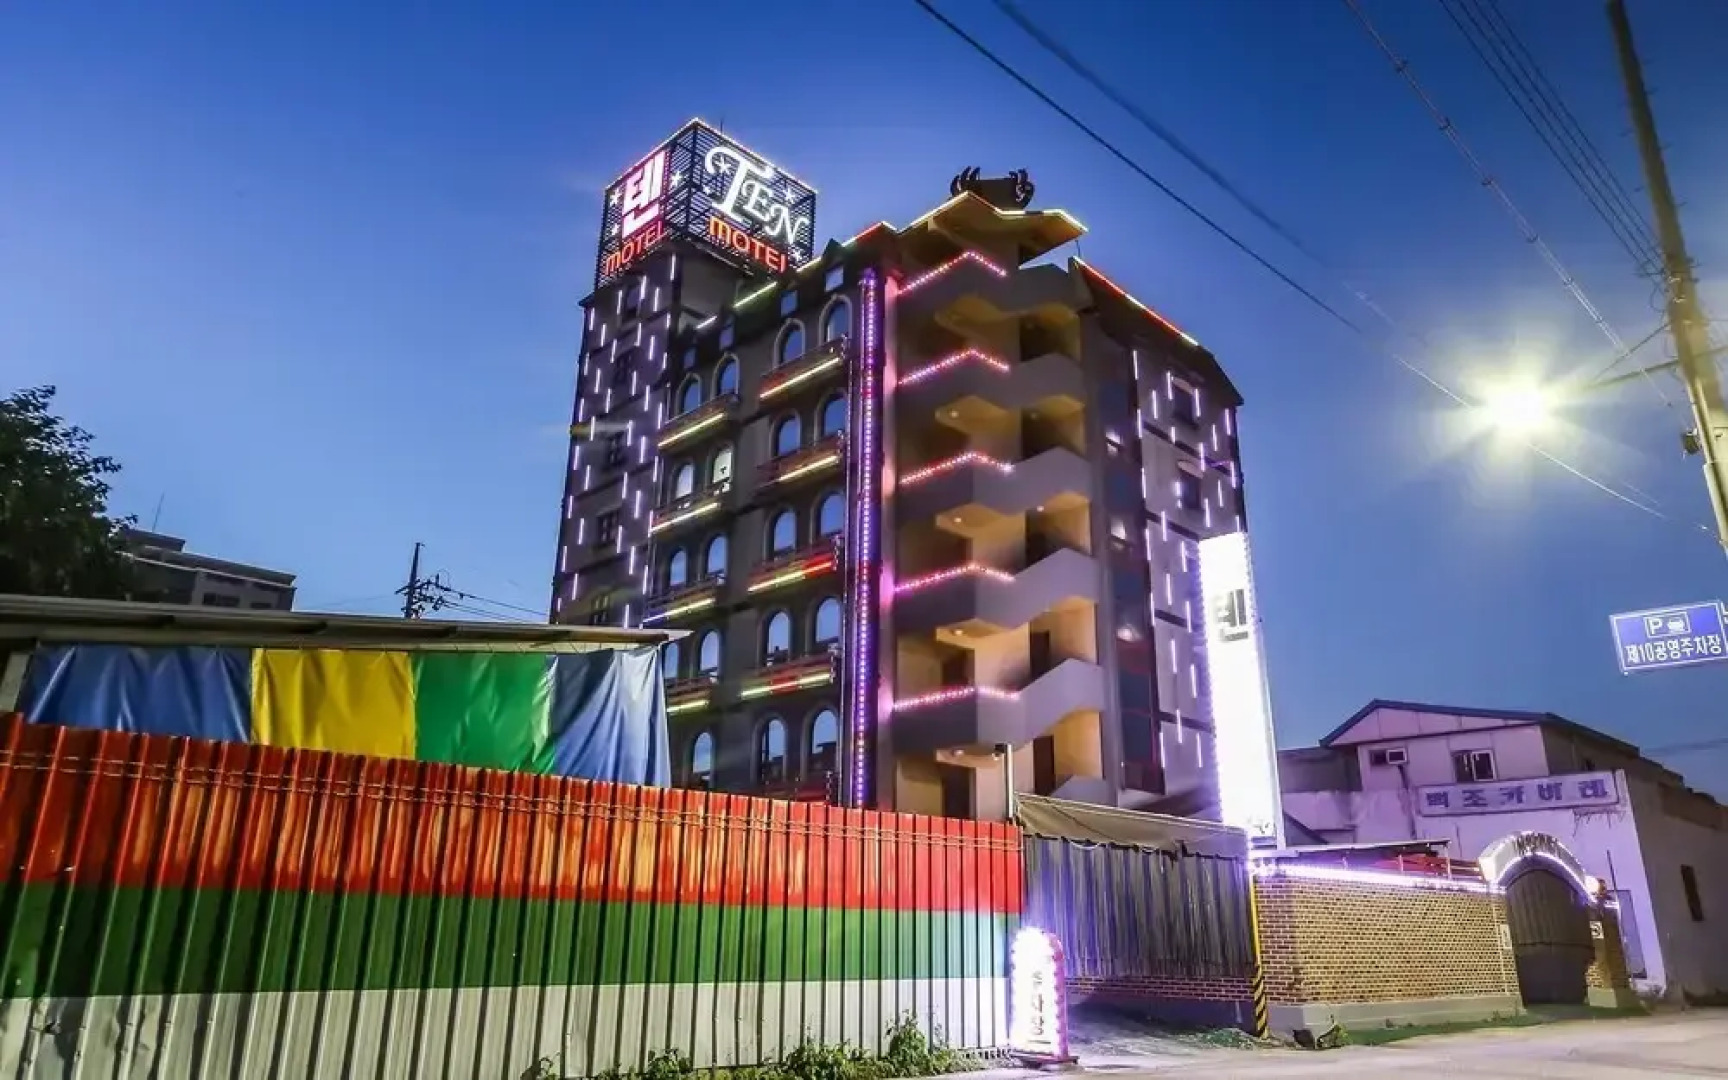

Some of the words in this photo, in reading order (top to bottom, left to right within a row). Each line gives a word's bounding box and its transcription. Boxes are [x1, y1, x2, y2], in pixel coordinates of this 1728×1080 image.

[622, 150, 666, 239] 텐
[604, 220, 667, 276] MOTEL
[1649, 618, 1663, 635] P
